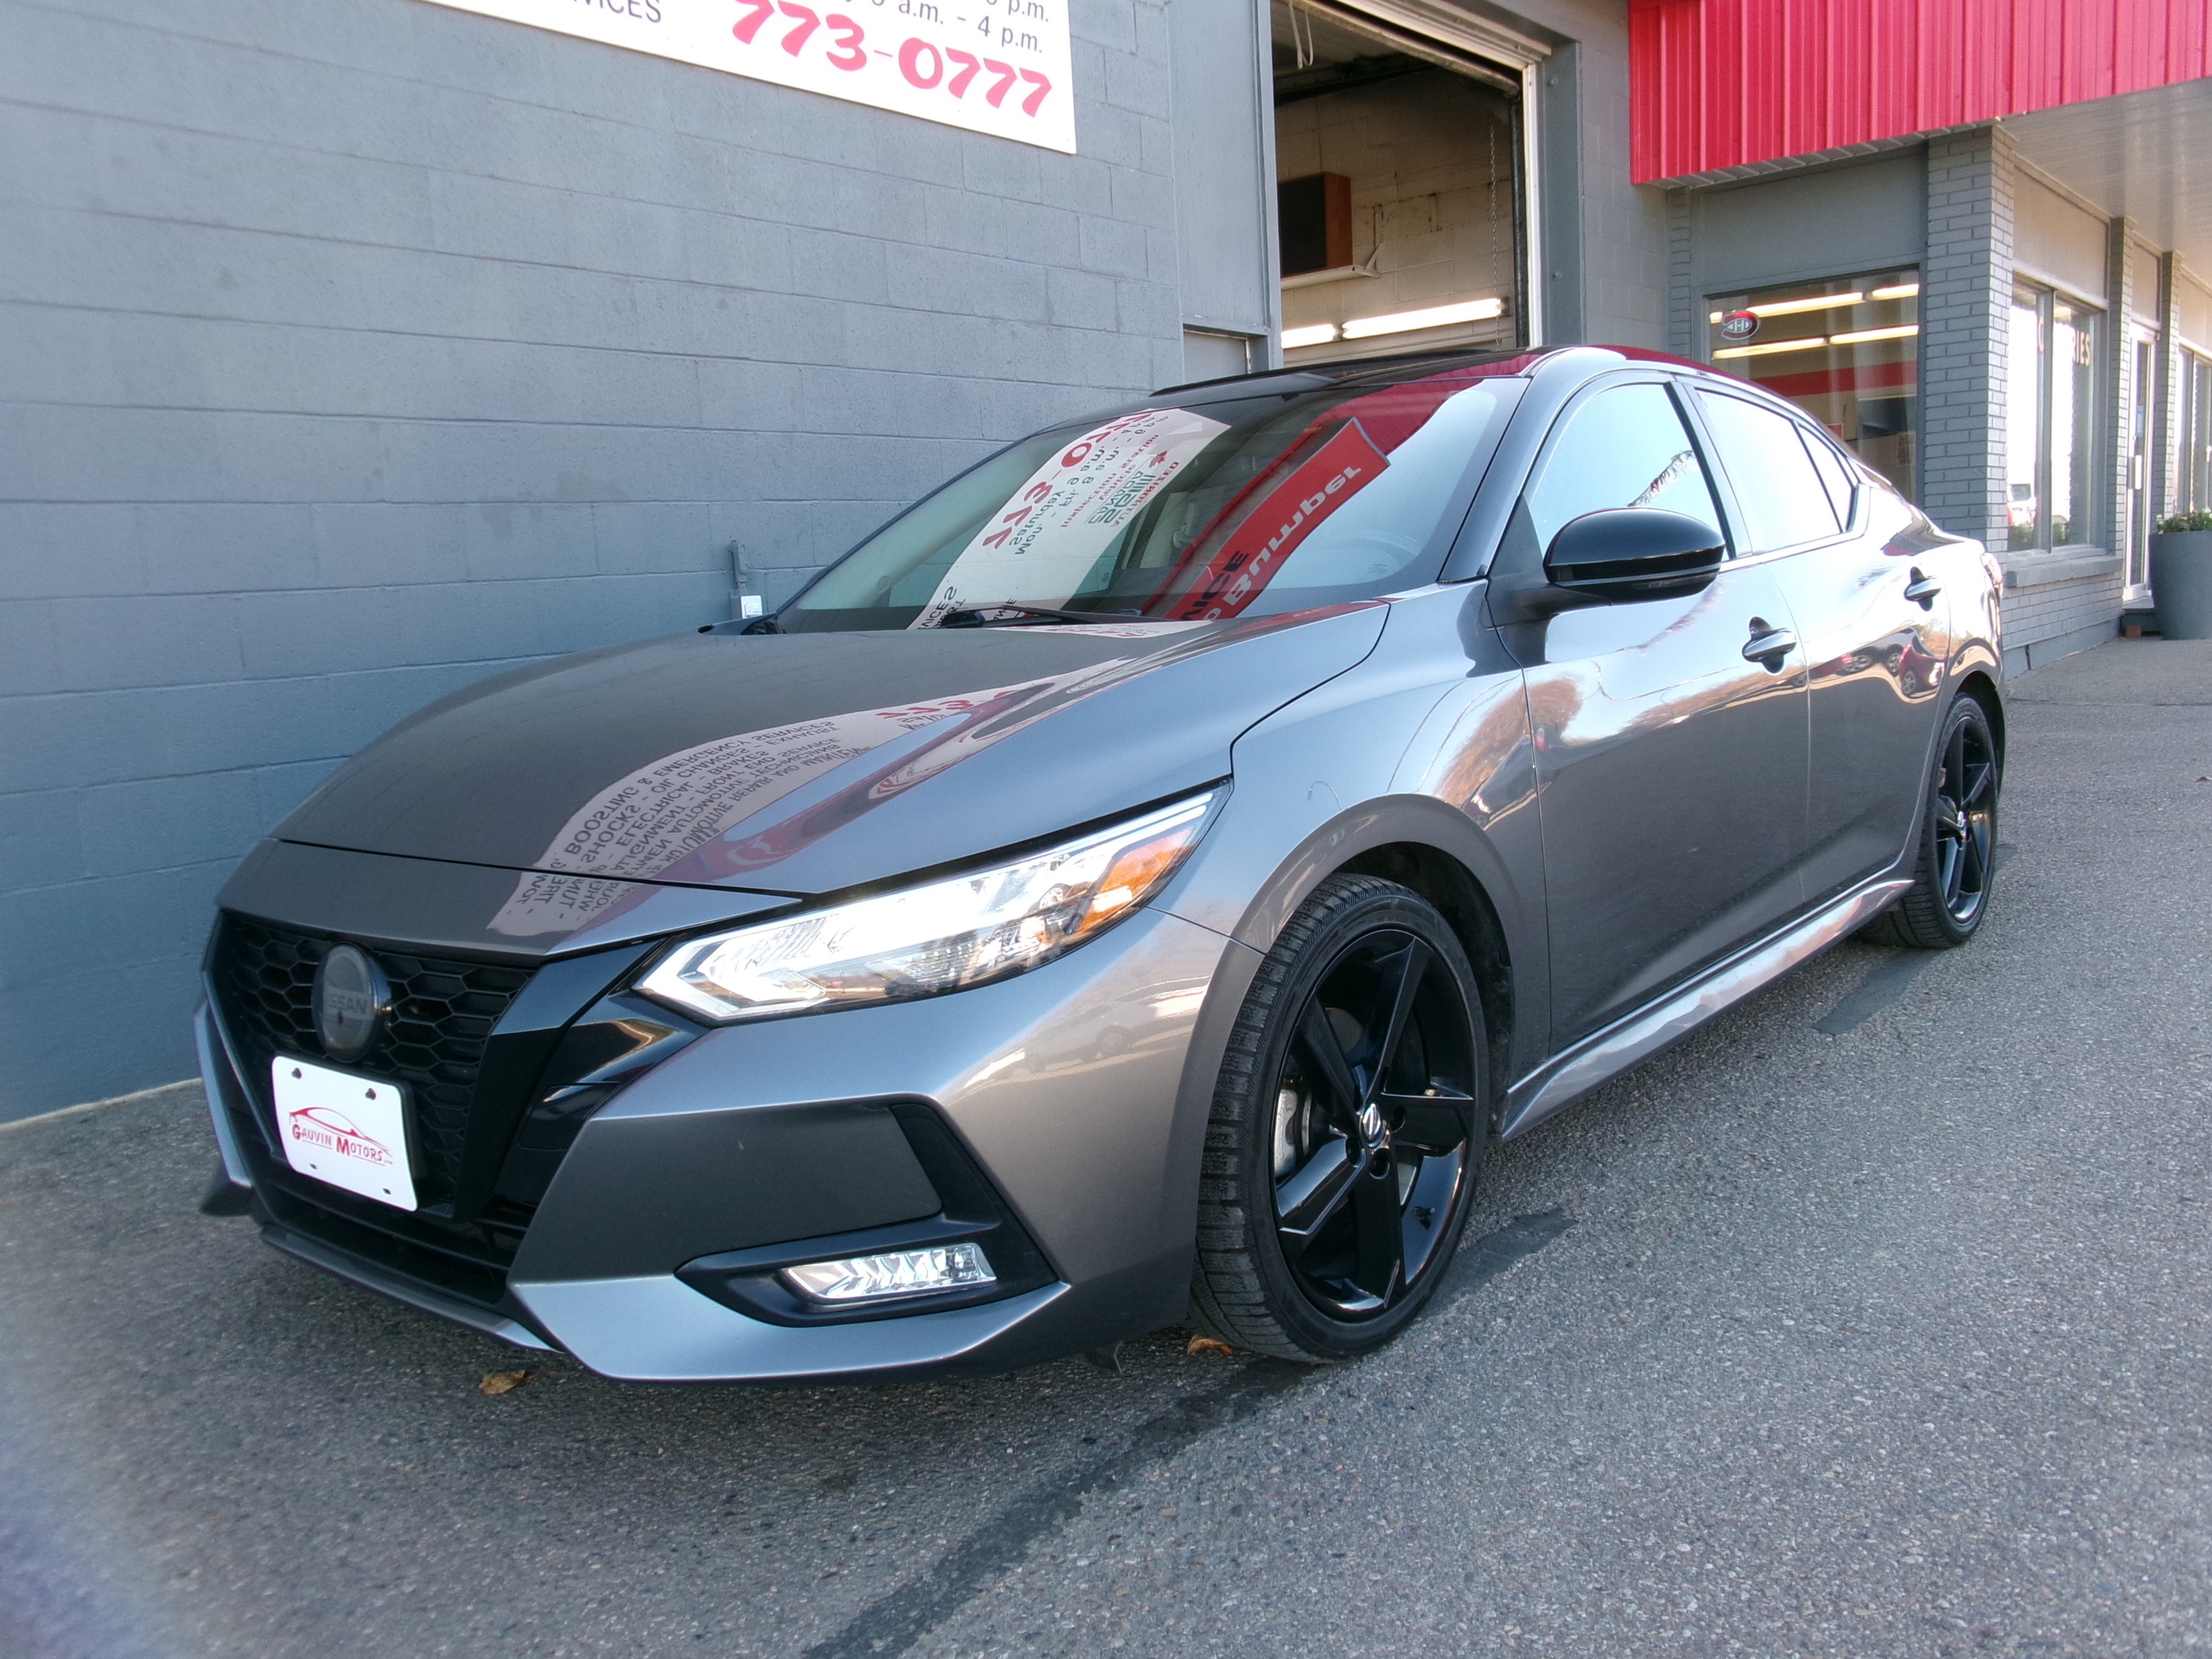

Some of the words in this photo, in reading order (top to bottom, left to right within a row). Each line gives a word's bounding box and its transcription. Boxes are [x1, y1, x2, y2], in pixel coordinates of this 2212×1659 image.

[898, 0, 944, 25] a.m.
[977, 15, 991, 38] 4
[1001, 27, 1043, 54] p.m.
[1008, 0, 1049, 22] p.m.
[732, 0, 1053, 118] 773-0777
[292, 1124, 332, 1146] GAUVIN
[336, 1136, 382, 1161] MOTORS
